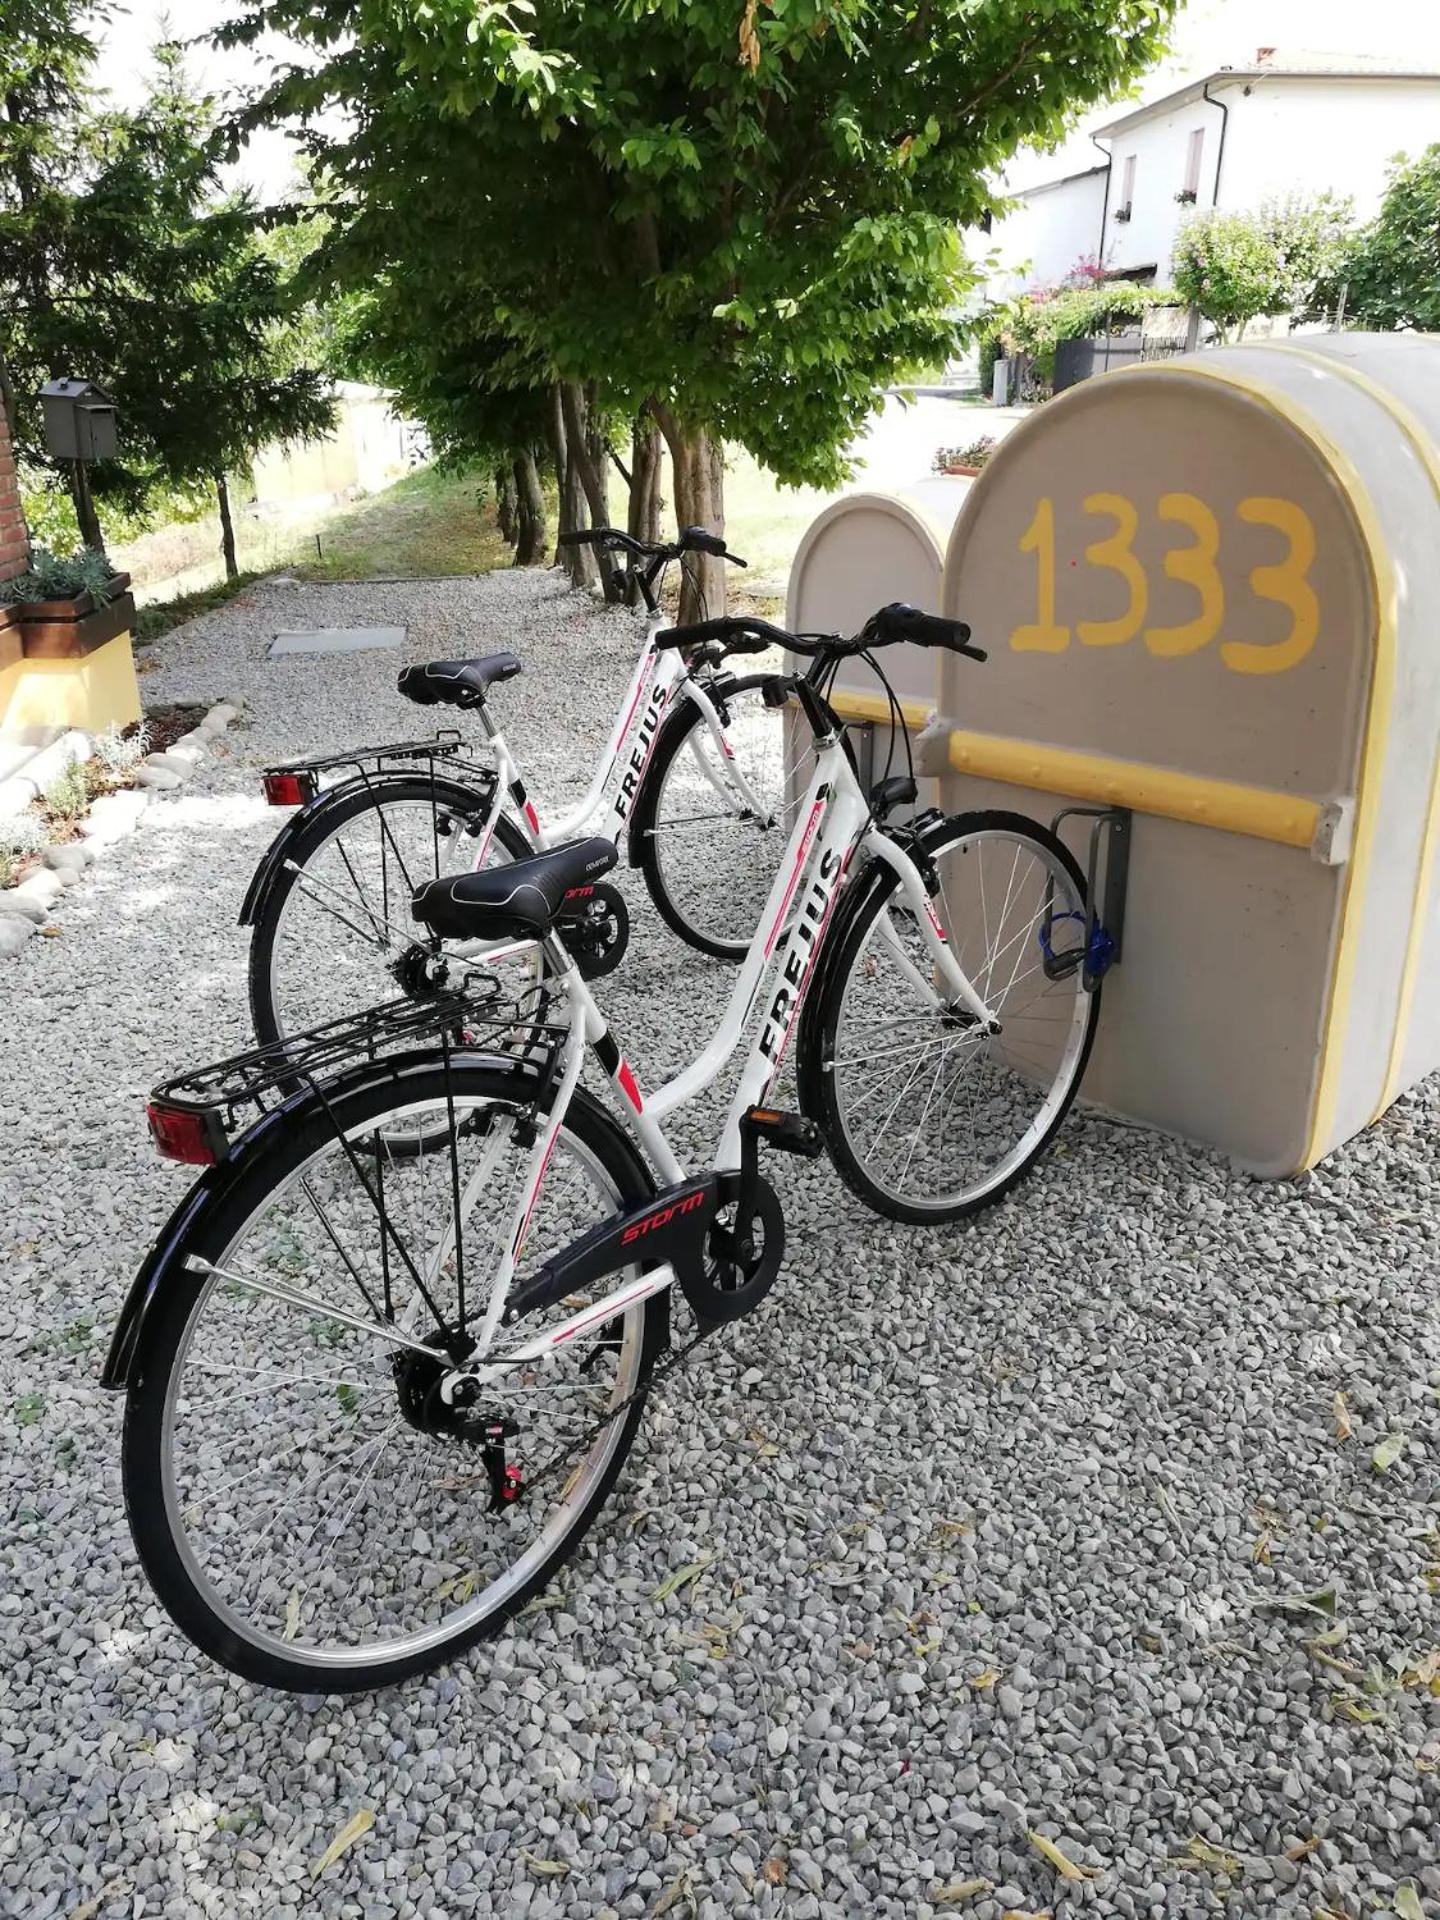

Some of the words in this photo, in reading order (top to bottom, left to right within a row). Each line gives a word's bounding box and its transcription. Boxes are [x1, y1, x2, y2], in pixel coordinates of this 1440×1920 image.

[1009, 492, 1320, 674] 1333
[614, 684, 667, 820] FREJUS
[759, 848, 842, 1066] FREJUS
